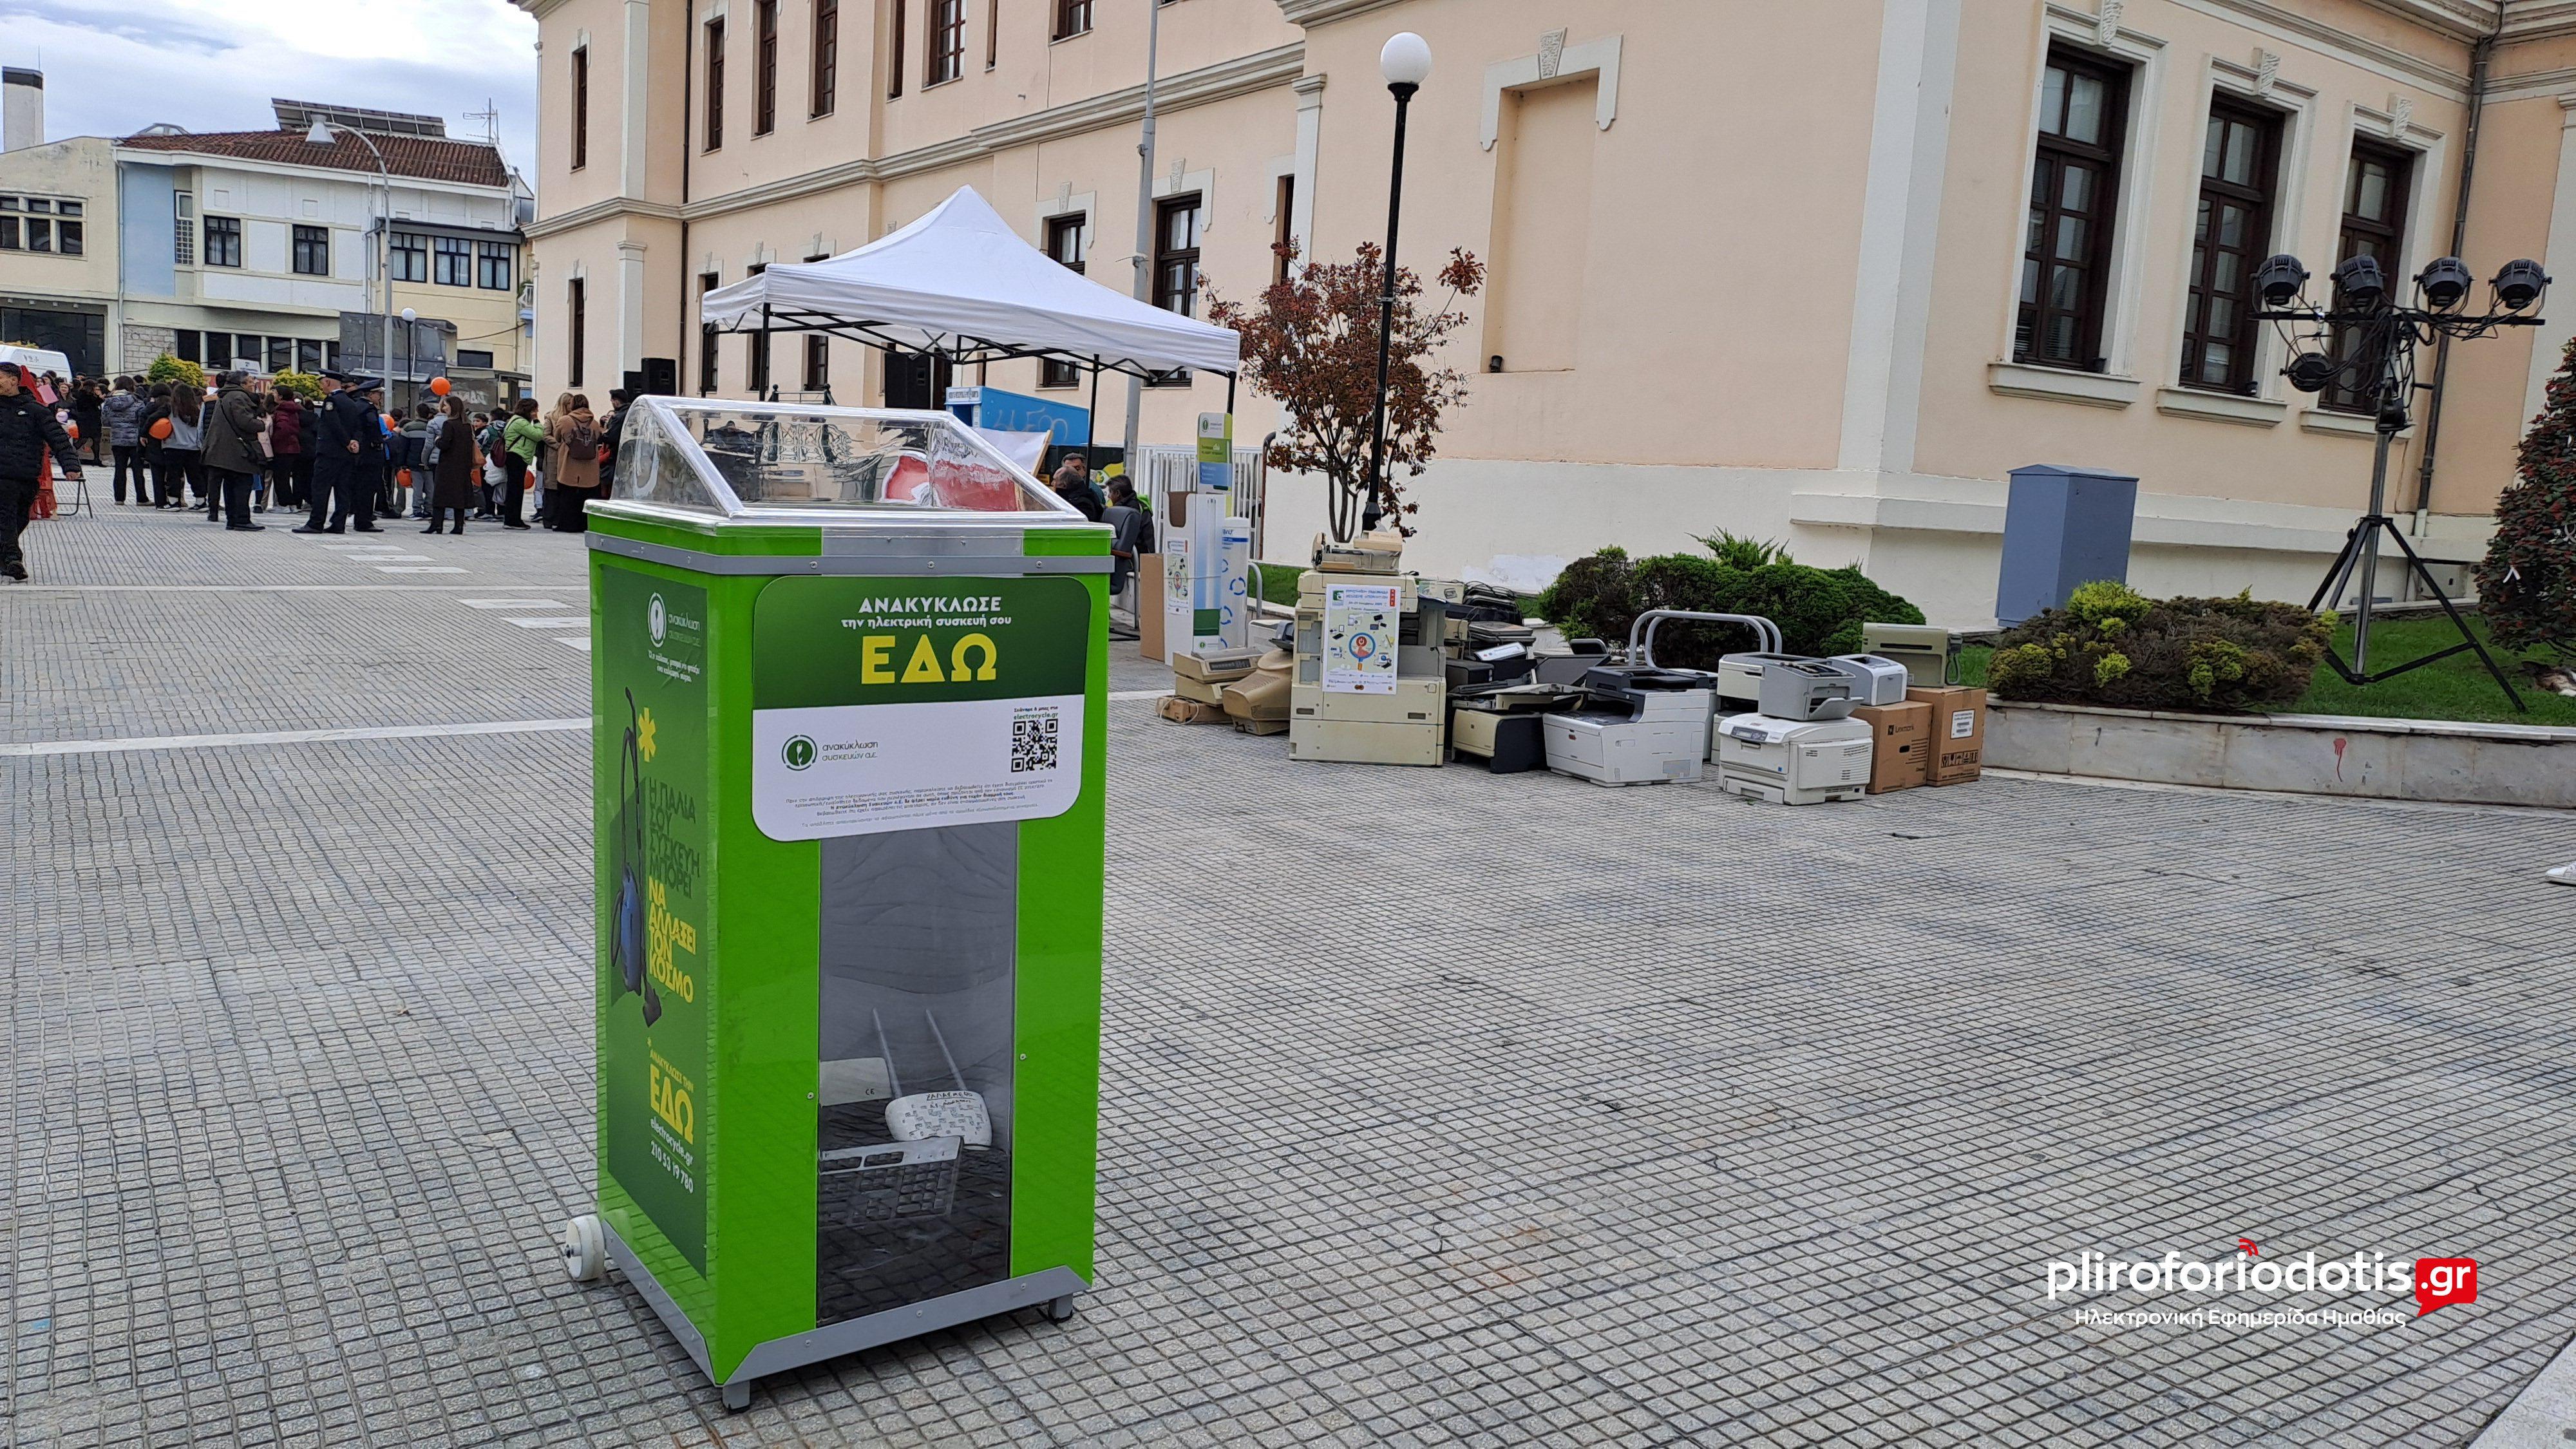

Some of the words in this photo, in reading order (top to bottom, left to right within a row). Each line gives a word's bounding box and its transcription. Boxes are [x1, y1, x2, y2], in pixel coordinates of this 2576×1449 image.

[840, 619, 864, 630] την
[867, 614, 932, 629] ηλεκτρική
[936, 614, 987, 628] συσκευή
[989, 616, 1012, 625] σου
[858, 596, 1001, 613] ΑΝΑΚΥΚΛΩΣΕ
[861, 632, 997, 685] ΕΔΩ
[822, 739, 878, 752] ανακύκλωση
[822, 751, 863, 761] συσκευών
[650, 777, 657, 806] Η
[660, 781, 696, 824] ΠΑΛΙΑ
[650, 802, 672, 835] ΣΟΥ
[650, 828, 699, 878] ΣΥΣΚΕΥΗ
[649, 876, 667, 910] ΝΑ
[650, 855, 692, 899] ΜΠΟΡΕΙ
[649, 902, 696, 956] ΑΛΛΑΞΕΙ
[649, 925, 672, 966] ΤΟΝ
[649, 948, 694, 1003] ΚΟΣΜΟ
[650, 1063, 694, 1145] ΕΔΩ
[650, 1116, 693, 1166] electrocycle.gr
[650, 1140, 662, 1162] 210
[662, 1152, 671, 1171] 53
[672, 1160, 679, 1179] 19
[680, 1170, 694, 1194] 780
